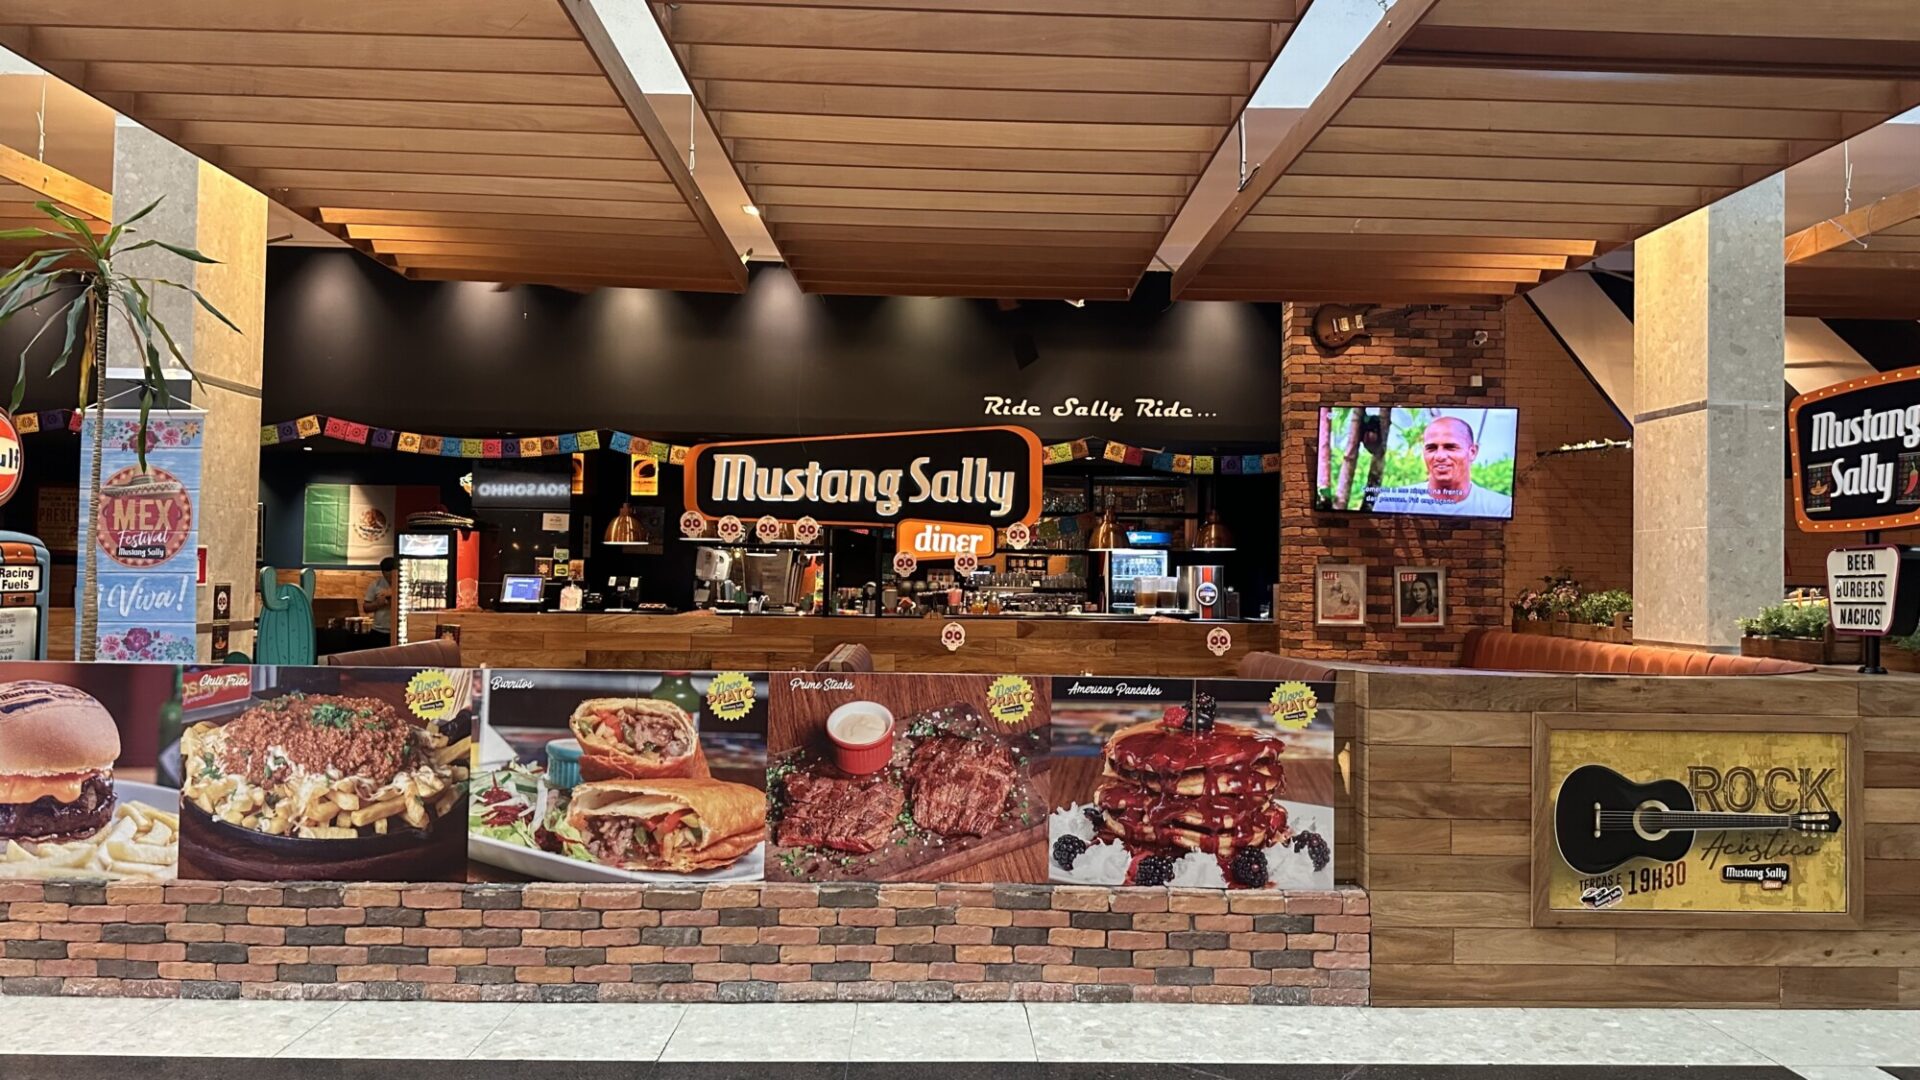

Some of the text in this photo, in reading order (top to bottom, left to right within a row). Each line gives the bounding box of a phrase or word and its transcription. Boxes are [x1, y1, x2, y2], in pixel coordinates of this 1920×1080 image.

[984, 396, 1042, 416] Ride
[1053, 397, 1124, 422] Sally
[1811, 404, 1920, 452] Mustang
[712, 454, 1015, 517] Mustang Sally
[1830, 453, 1894, 504] Sally
[113, 499, 173, 531] MEX
[117, 527, 169, 548] Festival
[914, 525, 984, 552] diner
[118, 547, 165, 558] Mustang Sally
[1847, 554, 1875, 571] BEER
[0, 567, 34, 580] Racing
[2, 579, 30, 590] Fuels
[1836, 581, 1884, 598] BURGERS
[1840, 608, 1881, 625] NACHOS
[199, 673, 251, 687] Chili Fries
[490, 675, 535, 691] Burritos
[789, 677, 855, 691] Prime Steaks
[1067, 681, 1162, 697] American Pancakes
[405, 686, 455, 704] PRATO
[706, 687, 755, 705] PRATO
[985, 691, 1034, 708] PRATO
[1268, 696, 1317, 715] PRATO
[1687, 765, 1836, 813] ROCK
[1701, 828, 1821, 870] Acústico
[1628, 861, 1687, 896] 19H30
[1726, 867, 1788, 880] Mustang Sally
